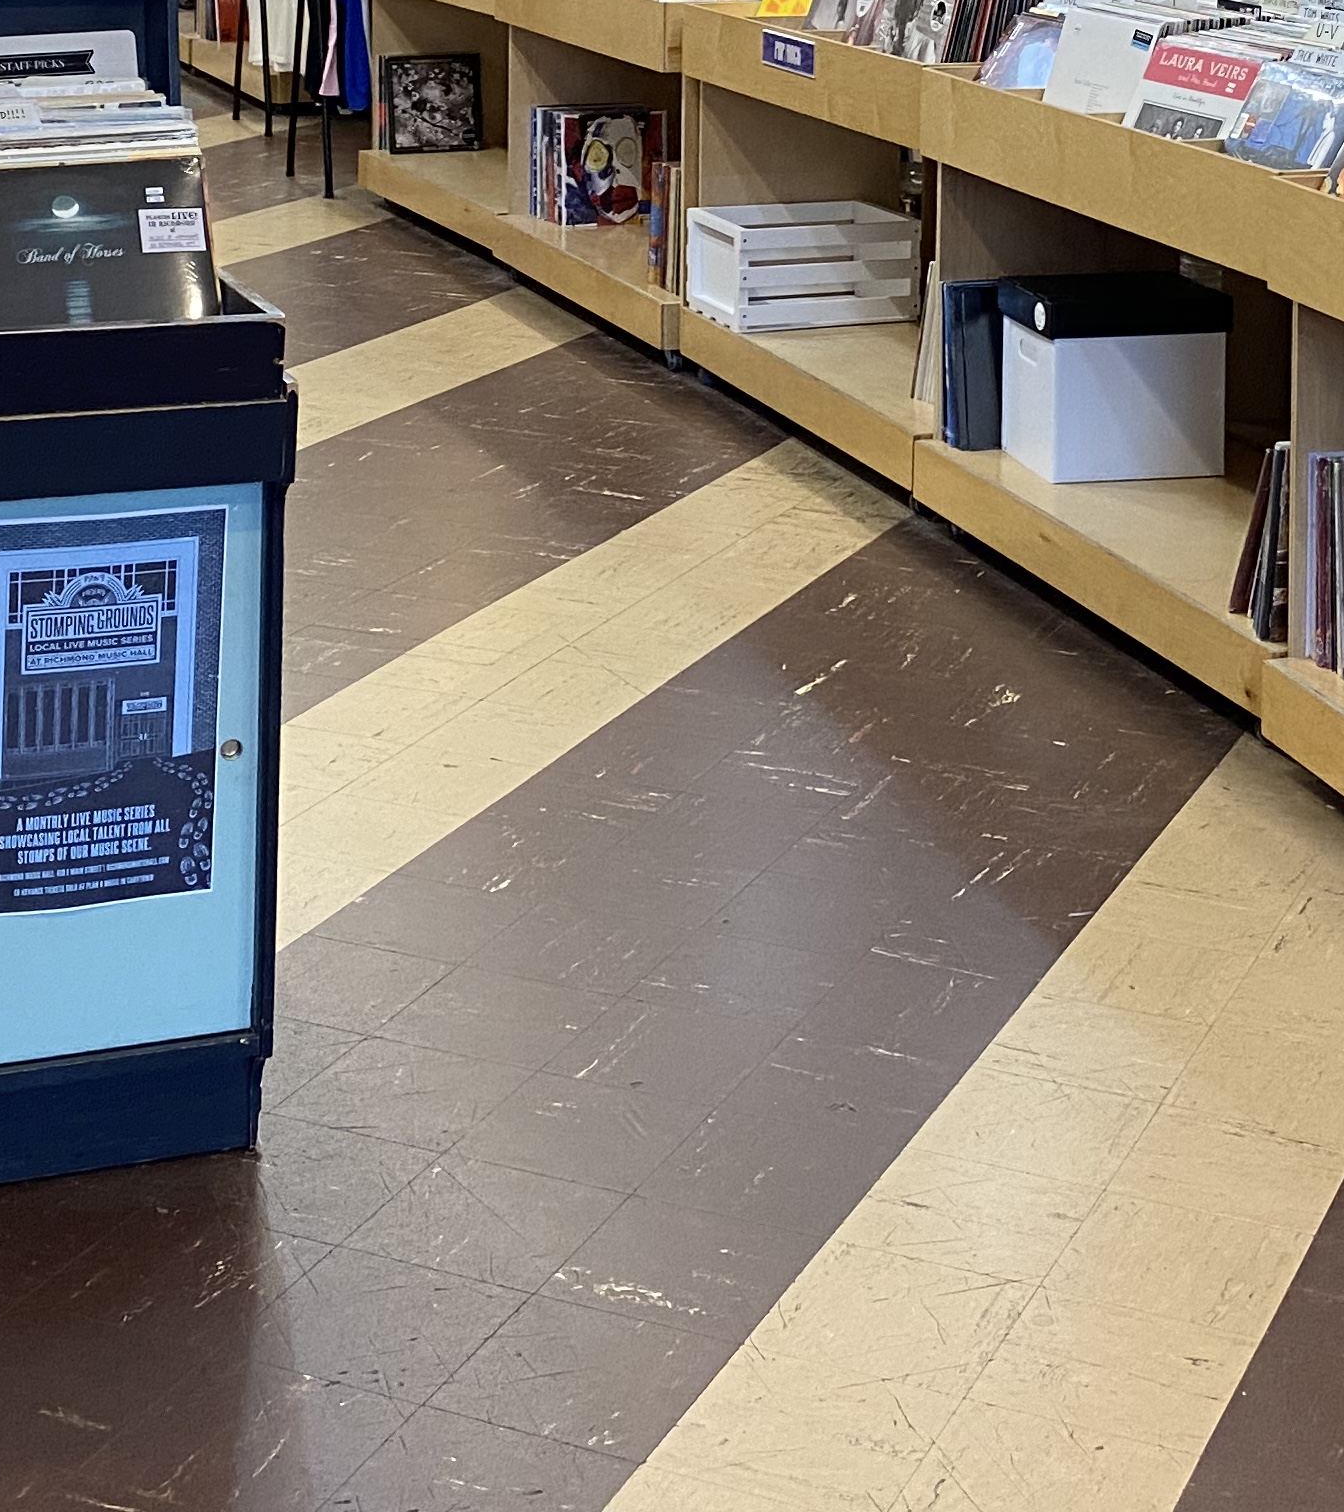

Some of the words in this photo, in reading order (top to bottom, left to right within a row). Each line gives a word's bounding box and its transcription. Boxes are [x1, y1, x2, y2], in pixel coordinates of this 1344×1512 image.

[1304, 7, 1316, 19] TOM
[1316, 22, 1338, 40] U-V
[0, 60, 29, 72] STAFF
[31, 58, 65, 71] PICKS
[1159, 51, 1203, 73] LAURA
[1209, 61, 1249, 81] VEIRS
[1316, 54, 1338, 68] WHITE
[17, 249, 58, 266] Band
[64, 245, 80, 264] of
[80, 243, 125, 267] Horses
[30, 614, 94, 639] STOMPING
[97, 605, 154, 630] GROUNDS
[16, 818, 24, 832] A
[25, 813, 69, 831] MONTHLY
[71, 811, 91, 827] LIVE
[93, 807, 122, 824] MUSIC
[124, 804, 156, 820] SERIES
[62, 828, 91, 845] LOCAL
[93, 824, 125, 841] TALENT
[127, 820, 153, 837] FROM
[154, 818, 171, 833] ALL
[17, 848, 55, 865] STOMPS
[56, 846, 67, 861] OF
[70, 844, 89, 860] OUR
[90, 840, 119, 857] MUSIC
[121, 837, 152, 854] SCENE.
